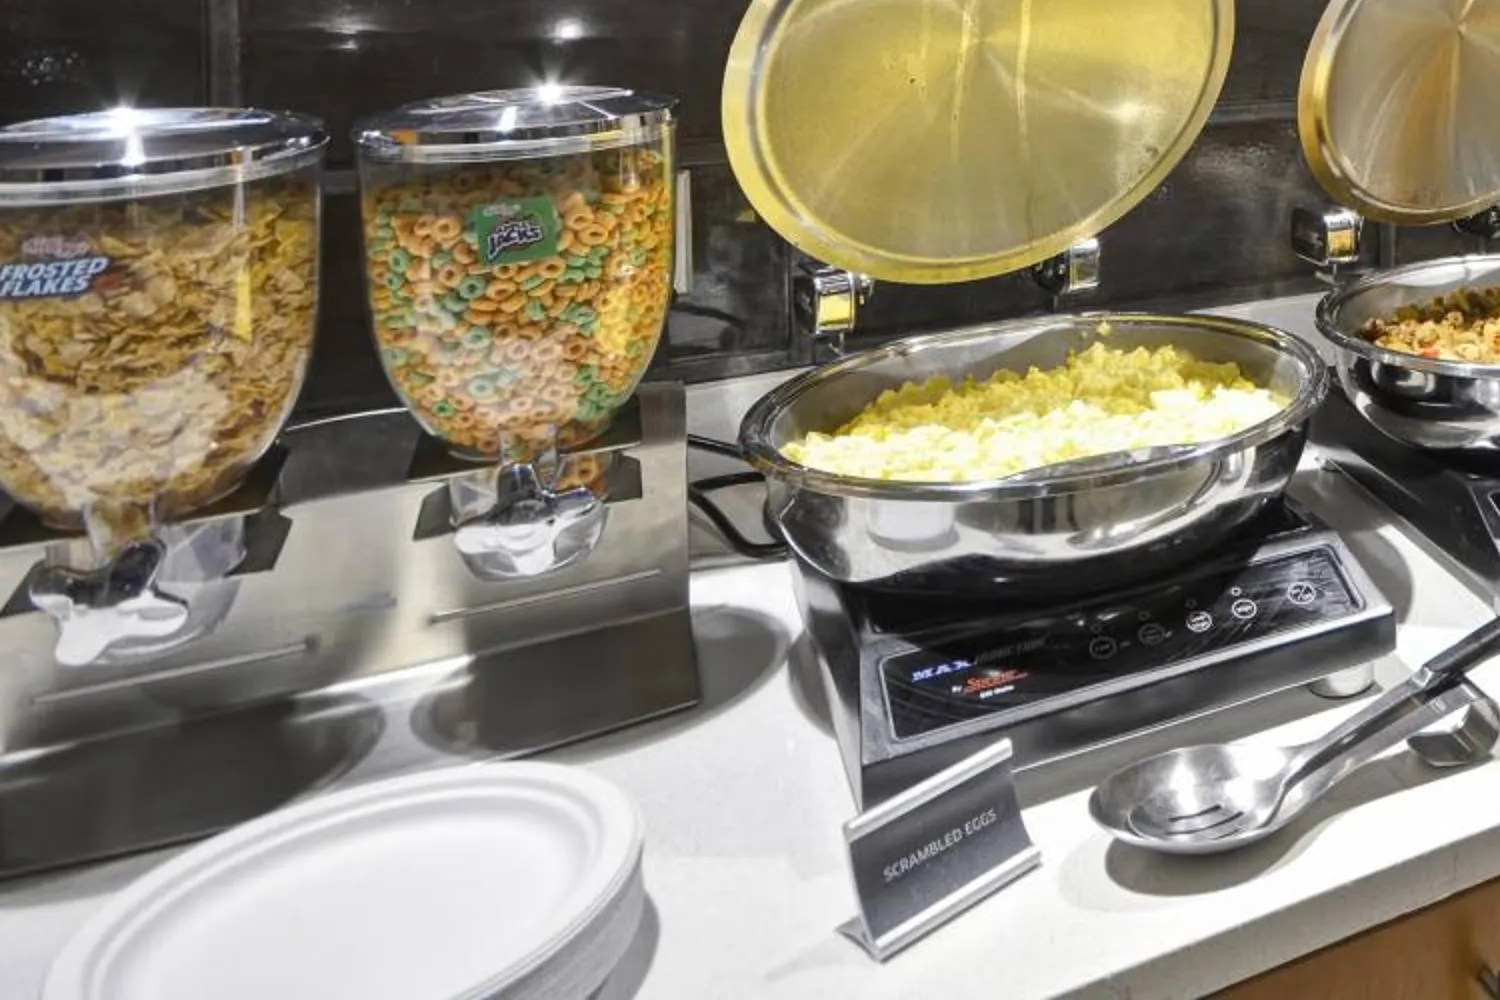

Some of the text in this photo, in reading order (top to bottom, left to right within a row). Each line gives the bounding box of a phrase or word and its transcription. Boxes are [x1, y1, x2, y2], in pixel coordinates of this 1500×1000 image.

[487, 227, 543, 260] JACKS
[0, 257, 109, 281] FROSTED
[0, 276, 89, 297] FLAKES
[911, 660, 972, 682] MAX
[882, 807, 998, 883] SCRAMBLED EGGS
